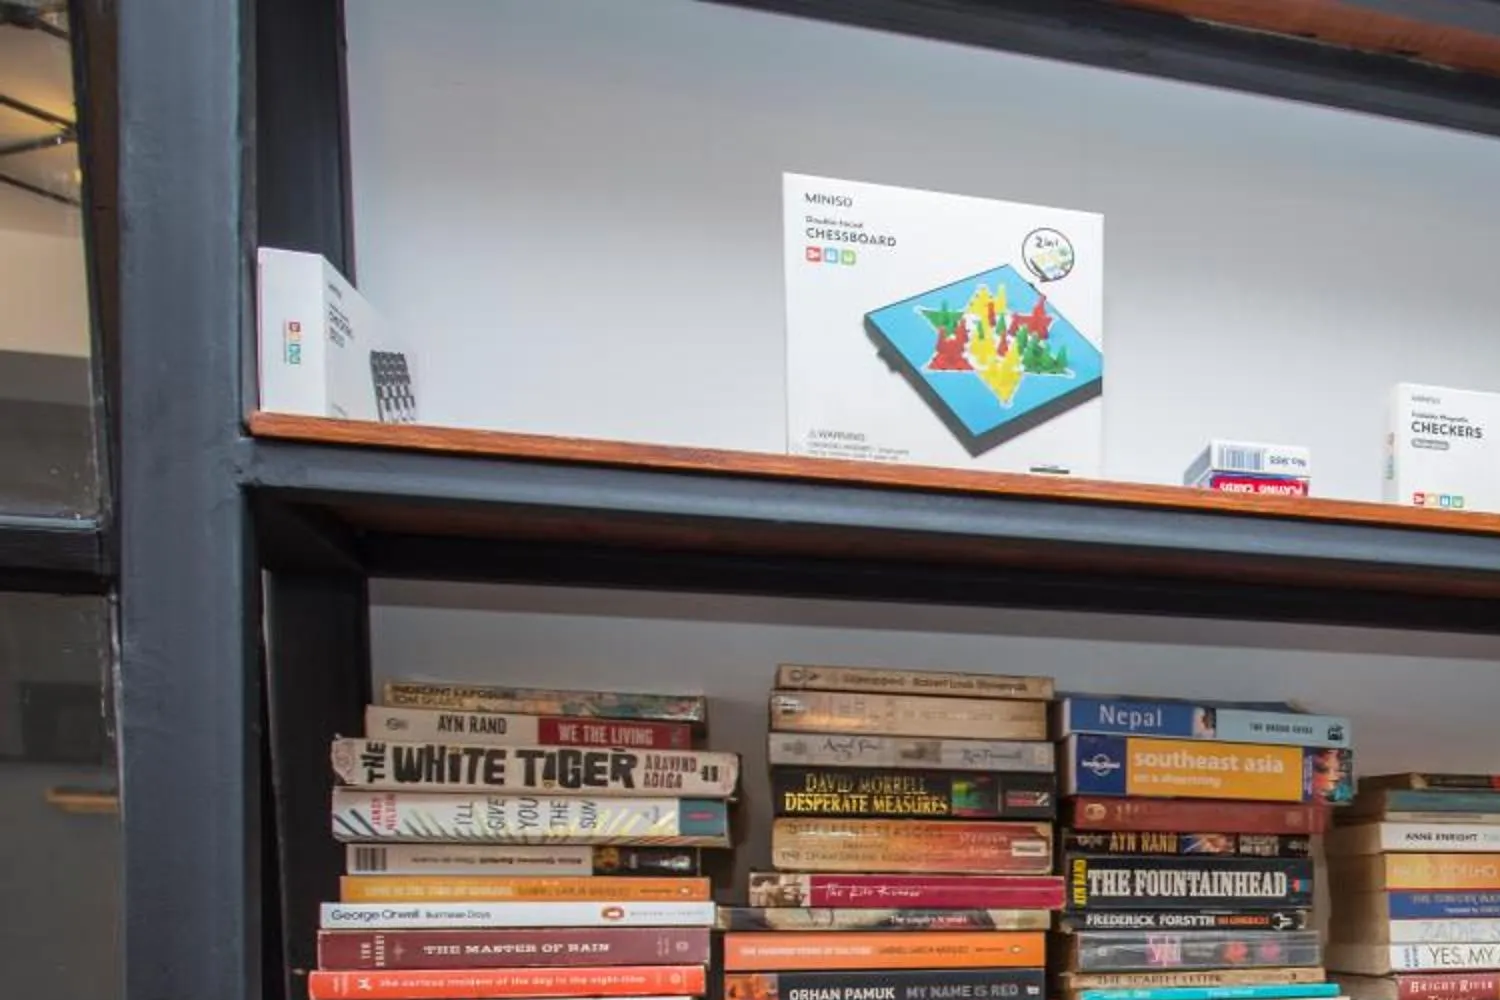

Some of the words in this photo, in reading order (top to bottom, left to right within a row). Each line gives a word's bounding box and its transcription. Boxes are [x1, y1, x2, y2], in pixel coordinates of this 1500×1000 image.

[804, 192, 853, 208] MINISO
[805, 227, 897, 247] CHESSBOARD
[1410, 420, 1483, 438] CHECKERS
[437, 714, 465, 733] AYN
[469, 717, 507, 735] RAND
[1099, 704, 1162, 731] Nepal
[558, 723, 578, 742] WE
[583, 724, 607, 744] THE
[611, 726, 654, 746] LIVING
[361, 742, 387, 783] THE
[392, 744, 507, 787] WHITE
[514, 746, 640, 790] TIGER
[644, 754, 697, 773] ARAVIND
[1133, 749, 1240, 772] southeast
[1244, 753, 1285, 775] asia
[644, 772, 683, 789] ADIGA
[803, 778, 850, 796] DAVID
[783, 793, 867, 813] DESPERATE
[871, 794, 948, 814] MEASURES
[487, 797, 506, 831] GIVE
[517, 797, 539, 831] YOU
[550, 800, 570, 828] THE
[580, 800, 598, 829] SUN
[1087, 869, 1130, 896] THE
[1133, 869, 1287, 898] FOUNTAINHEAD
[331, 909, 380, 923] George
[382, 908, 420, 920] Orwell
[1086, 912, 1154, 927] FREDERICK
[1159, 913, 1215, 927] FORSYTH
[423, 944, 460, 955] THE
[464, 944, 537, 955] MASTER
[541, 943, 563, 954] OF
[568, 942, 610, 953] RAIN
[1429, 946, 1464, 966] YES,
[1467, 947, 1496, 964] MY
[844, 986, 895, 1000] PAMUK
[905, 985, 926, 1000] MY
[929, 984, 971, 999] NAME
[974, 984, 988, 998] IS
[990, 983, 1019, 997] RED
[1409, 980, 1457, 994] BRIGHT
